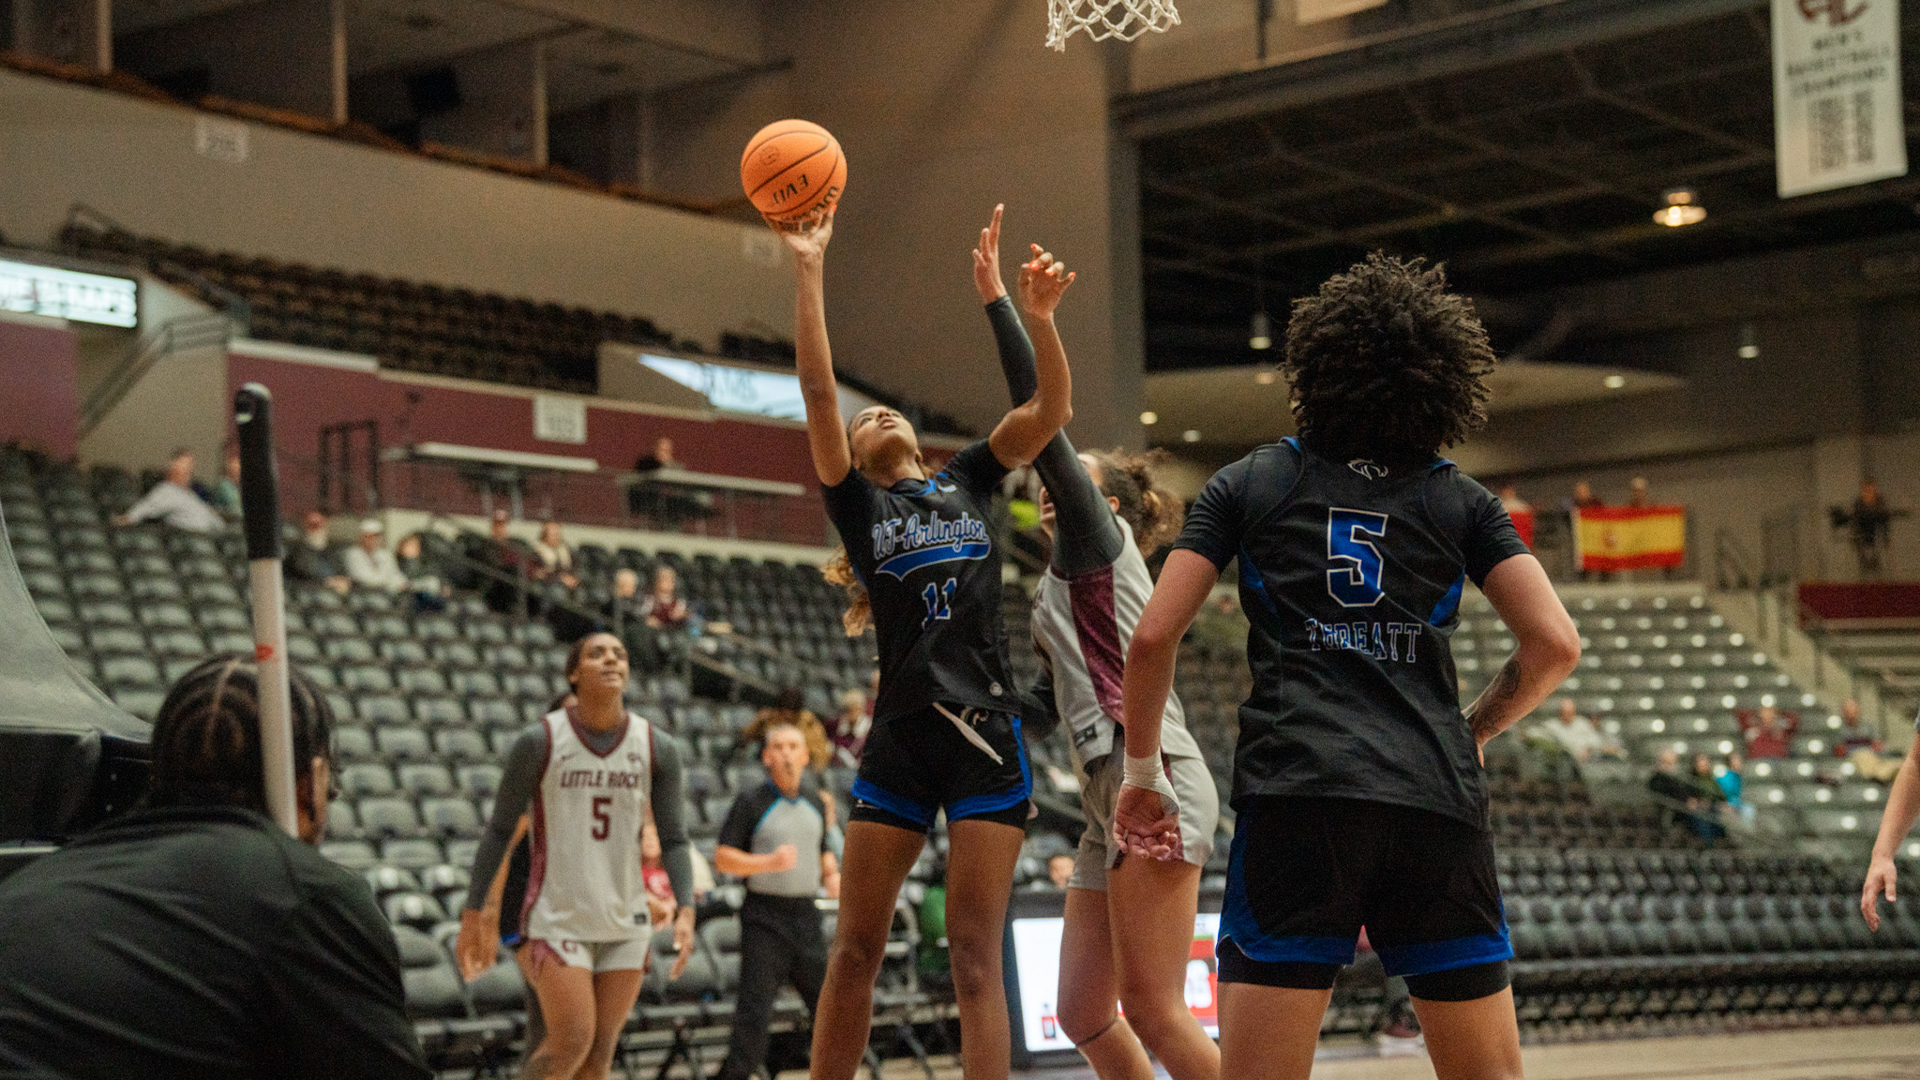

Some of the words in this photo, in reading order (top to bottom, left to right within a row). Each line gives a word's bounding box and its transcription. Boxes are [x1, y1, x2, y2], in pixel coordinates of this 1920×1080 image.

[1326, 507, 1388, 607] 5
[921, 577, 957, 630] 11
[560, 770, 604, 788] LITTLE
[591, 796, 612, 841] 5
